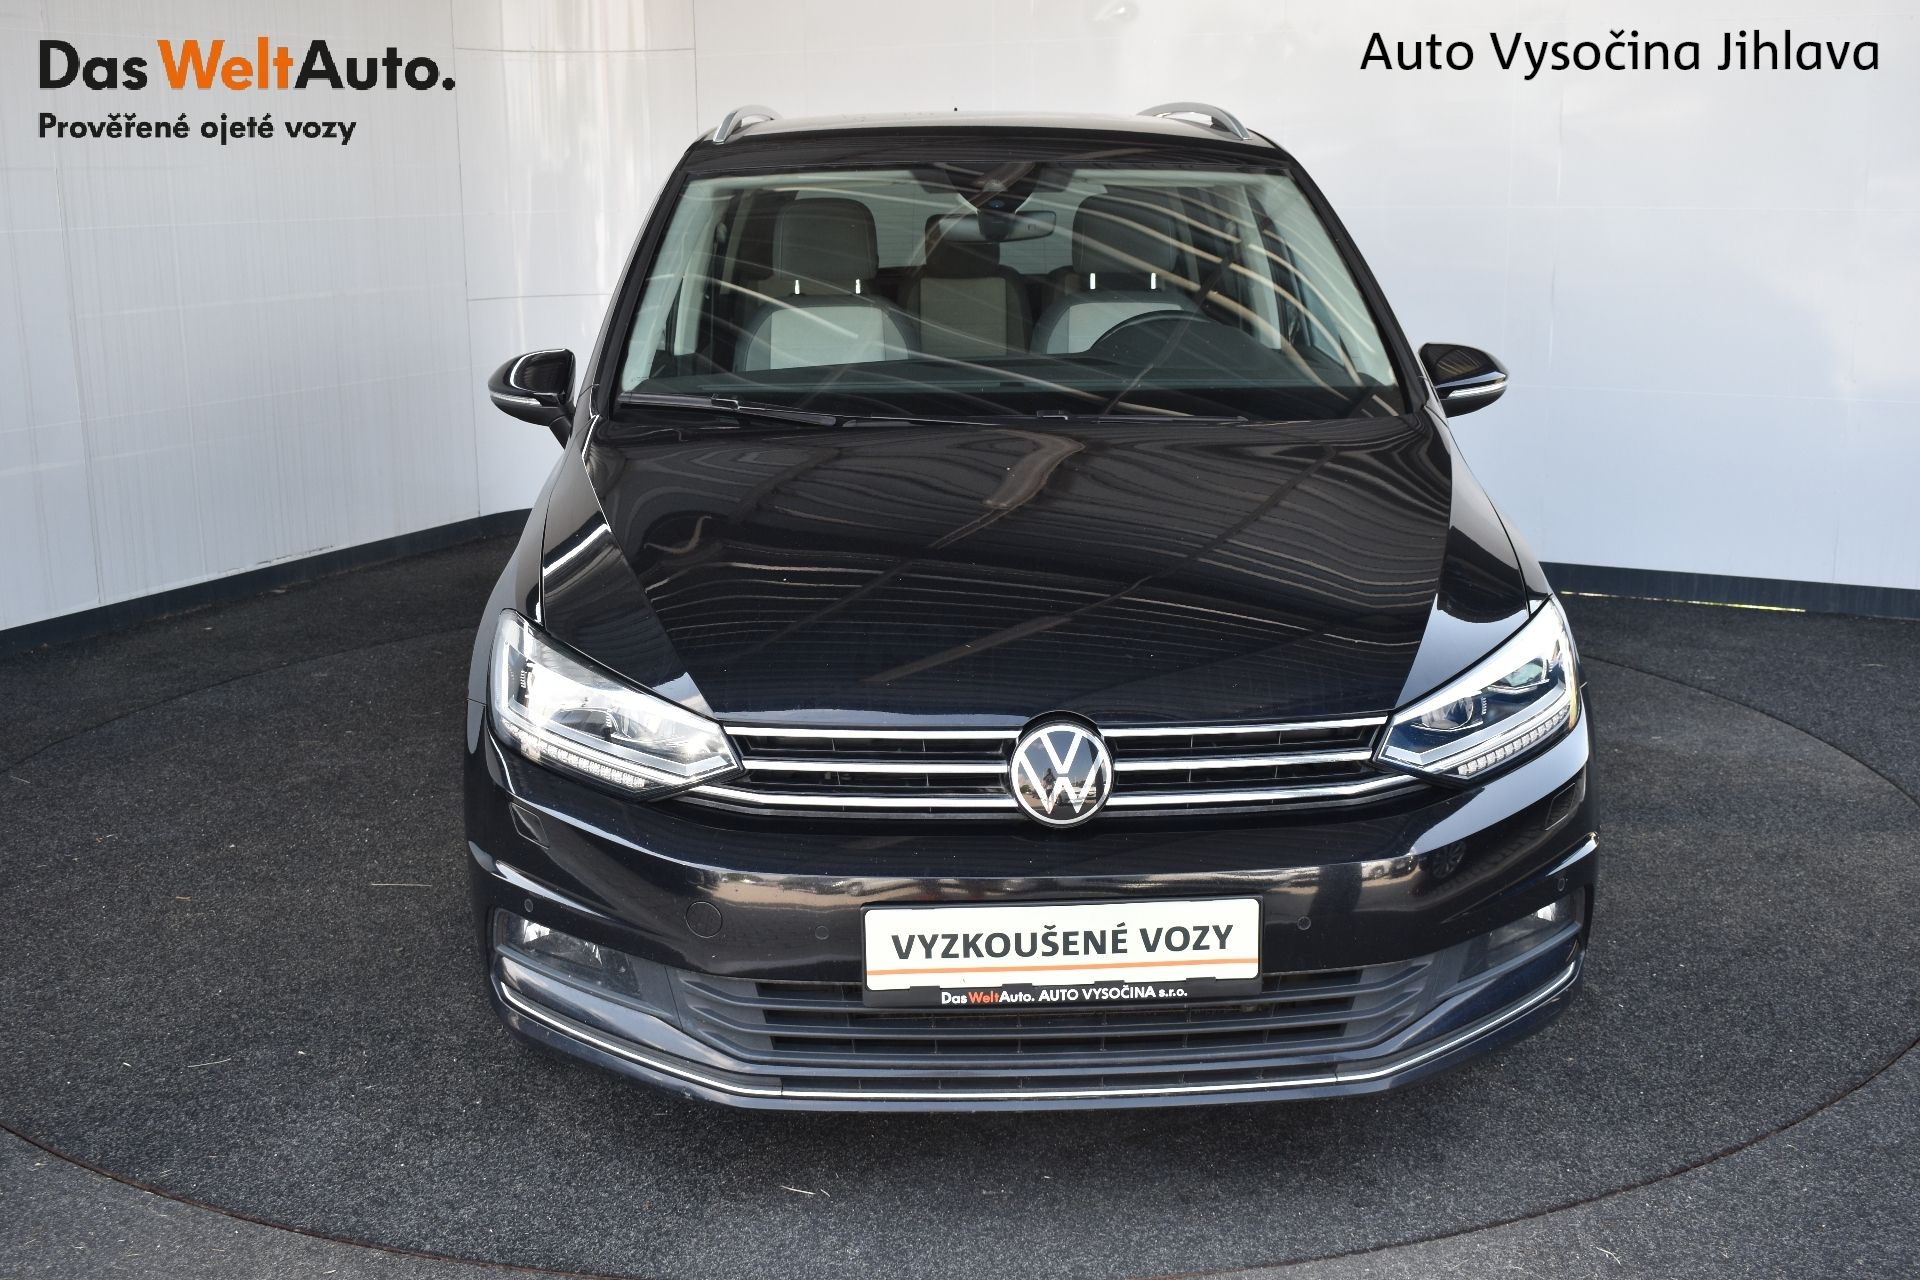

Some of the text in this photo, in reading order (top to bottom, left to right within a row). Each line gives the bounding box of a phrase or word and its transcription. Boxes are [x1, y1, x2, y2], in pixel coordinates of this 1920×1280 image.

[891, 922, 1233, 960] VYZKOUŠENÉ VOZY
[941, 984, 1188, 1005] Das WeltAuto. AUTO VYSOČINA s.r.o.
